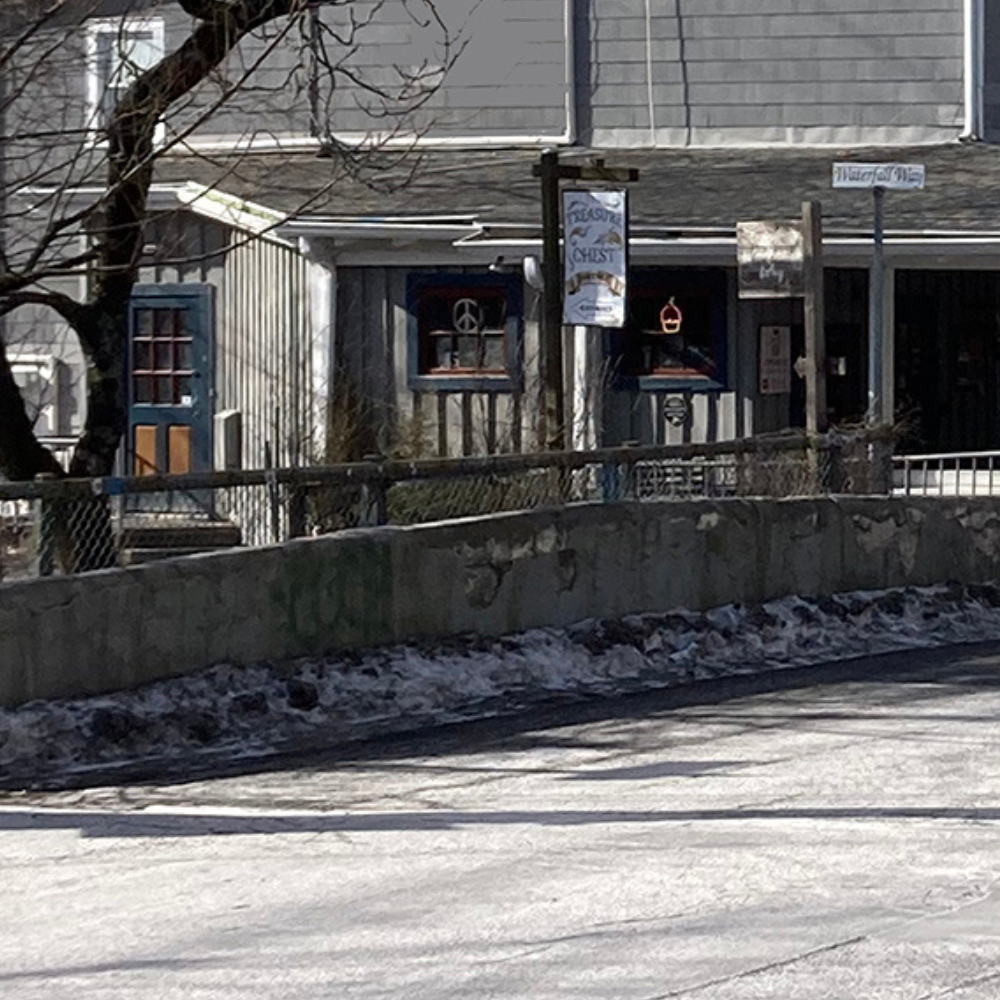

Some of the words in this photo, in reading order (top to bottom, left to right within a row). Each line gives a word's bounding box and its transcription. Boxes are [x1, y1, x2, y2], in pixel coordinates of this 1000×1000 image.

[835, 166, 893, 184] Waterfall
[896, 166, 923, 185] Way
[568, 208, 622, 227] TREASURE
[572, 248, 615, 264] CHEST
